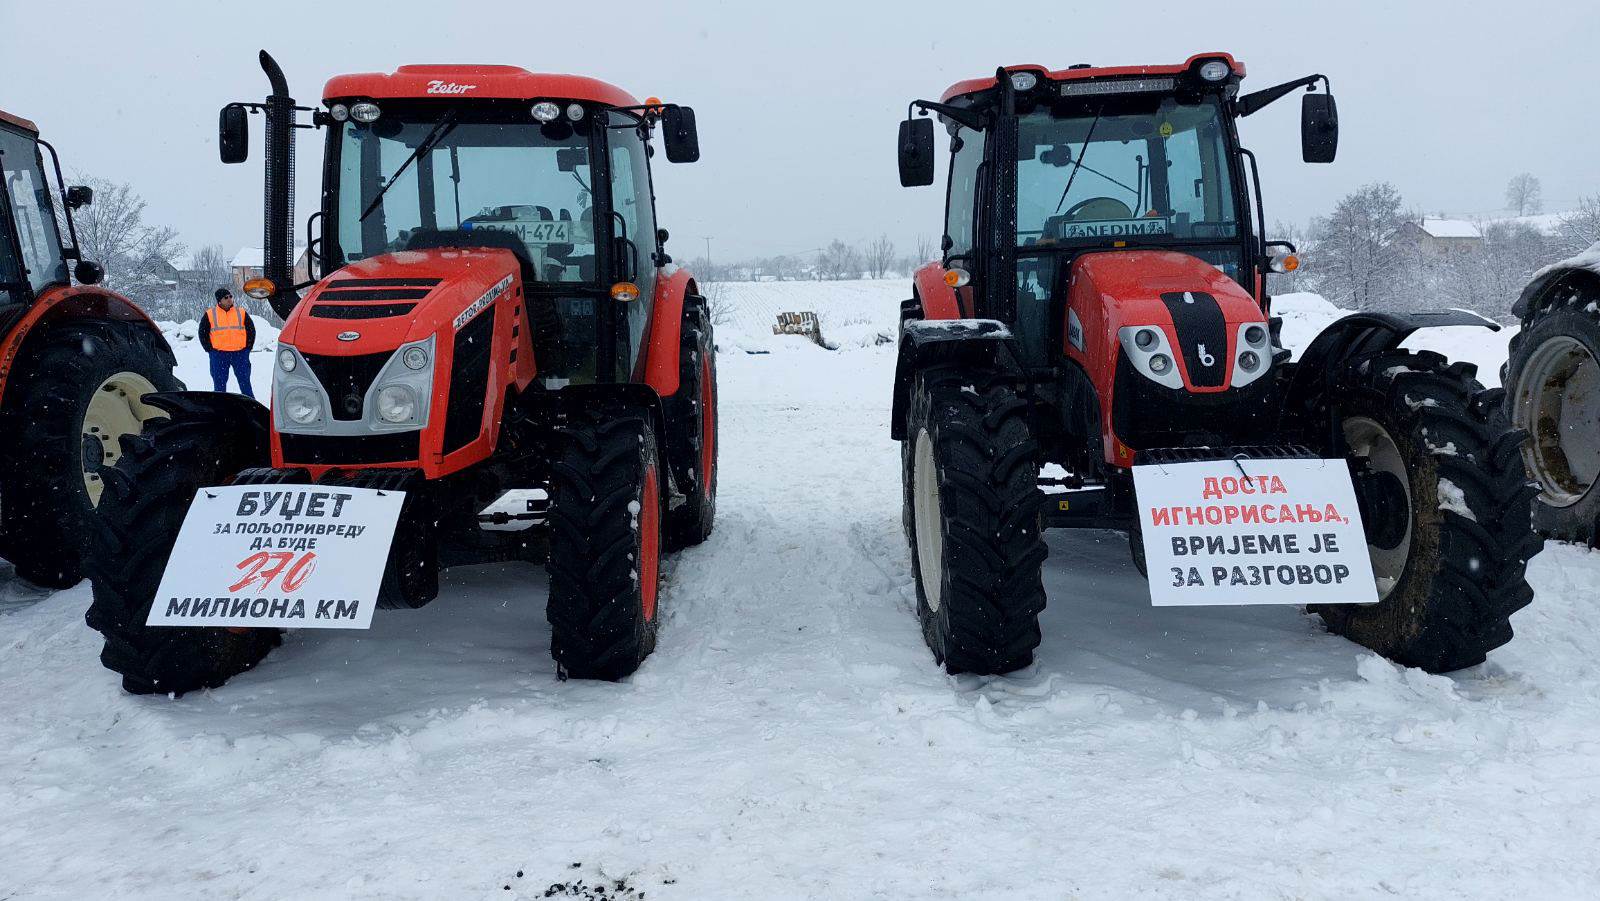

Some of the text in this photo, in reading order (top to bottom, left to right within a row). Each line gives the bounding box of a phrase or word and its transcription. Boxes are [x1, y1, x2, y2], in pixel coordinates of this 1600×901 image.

[427, 80, 477, 94] Zetor
[1086, 223, 1146, 237] NEDIM
[1203, 476, 1287, 499] ДОСТА
[236, 491, 352, 520] БУЏЕТ
[1152, 503, 1349, 526] ИГНОРИСАЊА,
[213, 523, 365, 538] ЗА ПОЉОПРИВРЕДУ
[250, 537, 317, 551] ДА БУДЕ
[1171, 533, 1339, 556] ВРИЈЕМЕ ЈЕ
[228, 551, 318, 594] 270
[1171, 565, 1350, 587] ЗА РАЗГОВОР
[166, 597, 359, 619] МИЛИОНА КМ
